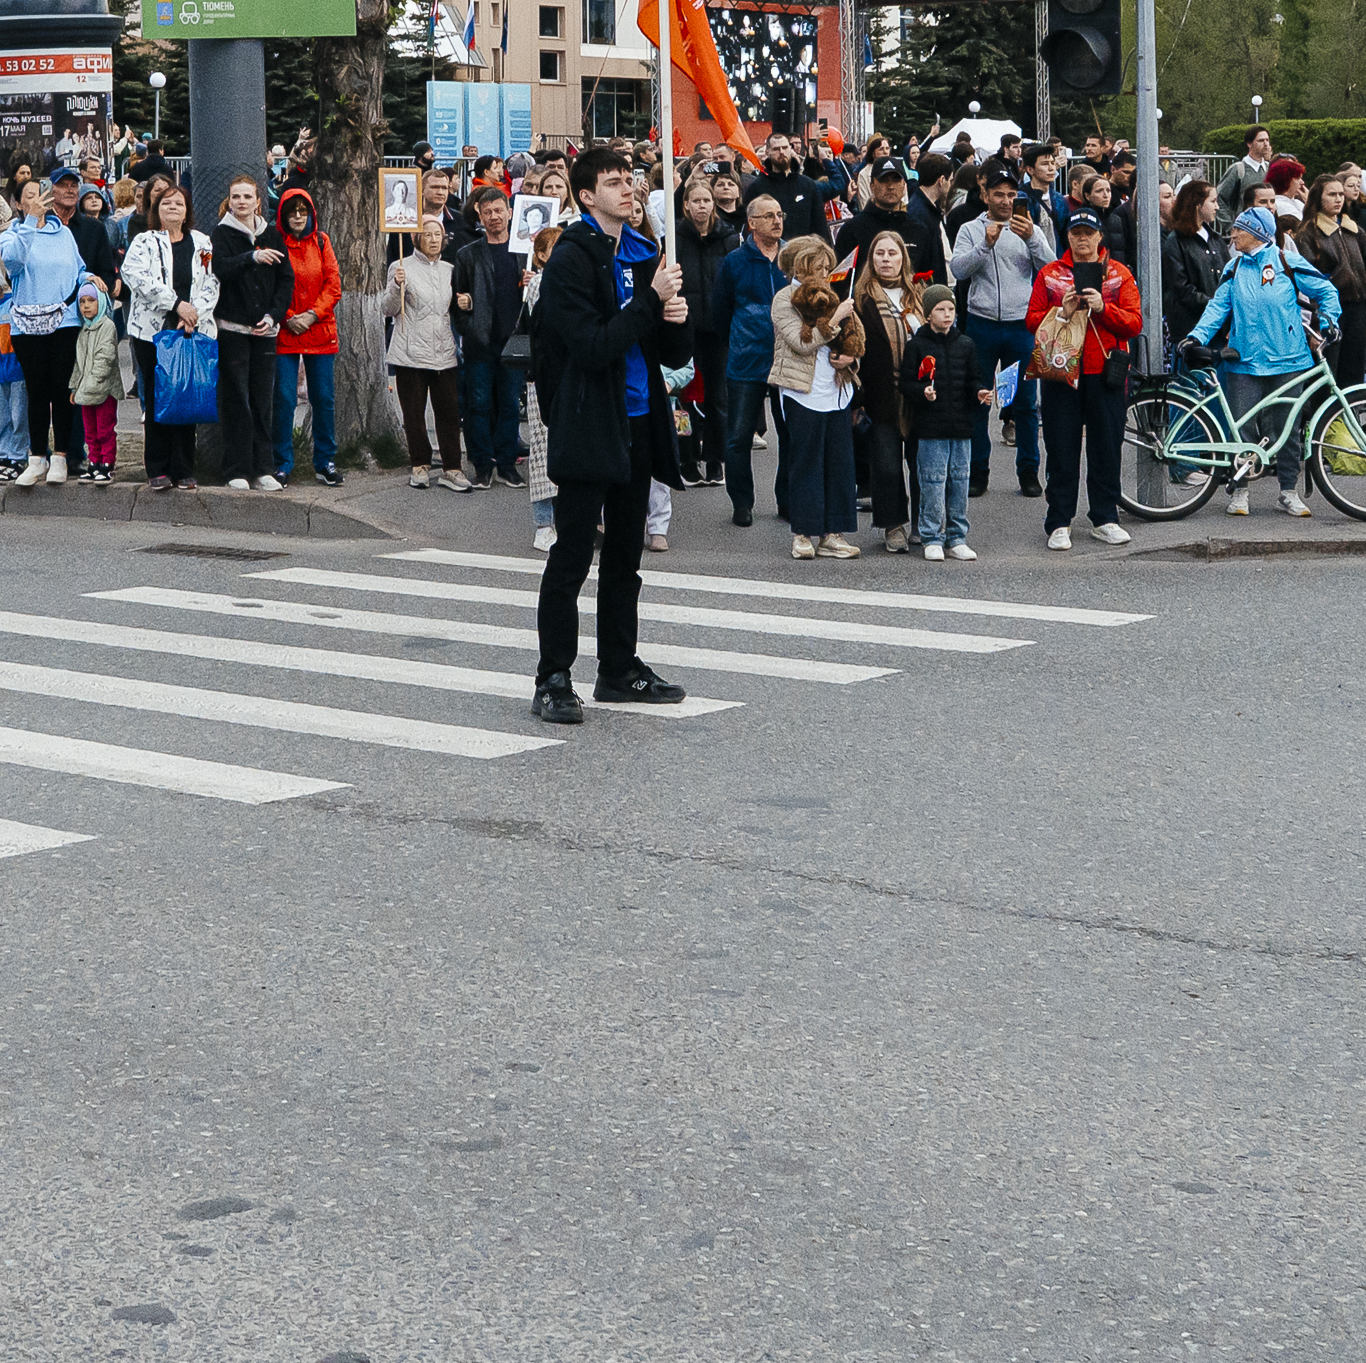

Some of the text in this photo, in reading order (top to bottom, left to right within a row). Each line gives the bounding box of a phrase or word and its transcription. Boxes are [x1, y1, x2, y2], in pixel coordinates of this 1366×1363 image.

[202, 1, 235, 12] ТЮМЕНЬ
[6, 59, 19, 72] 53
[21, 58, 37, 72] 02
[39, 57, 55, 71] 52
[73, 57, 111, 74] афи
[2, 114, 52, 124] НОЧЬ МУЗЕЕВ
[0, 125, 26, 137] 17 МАЯ
